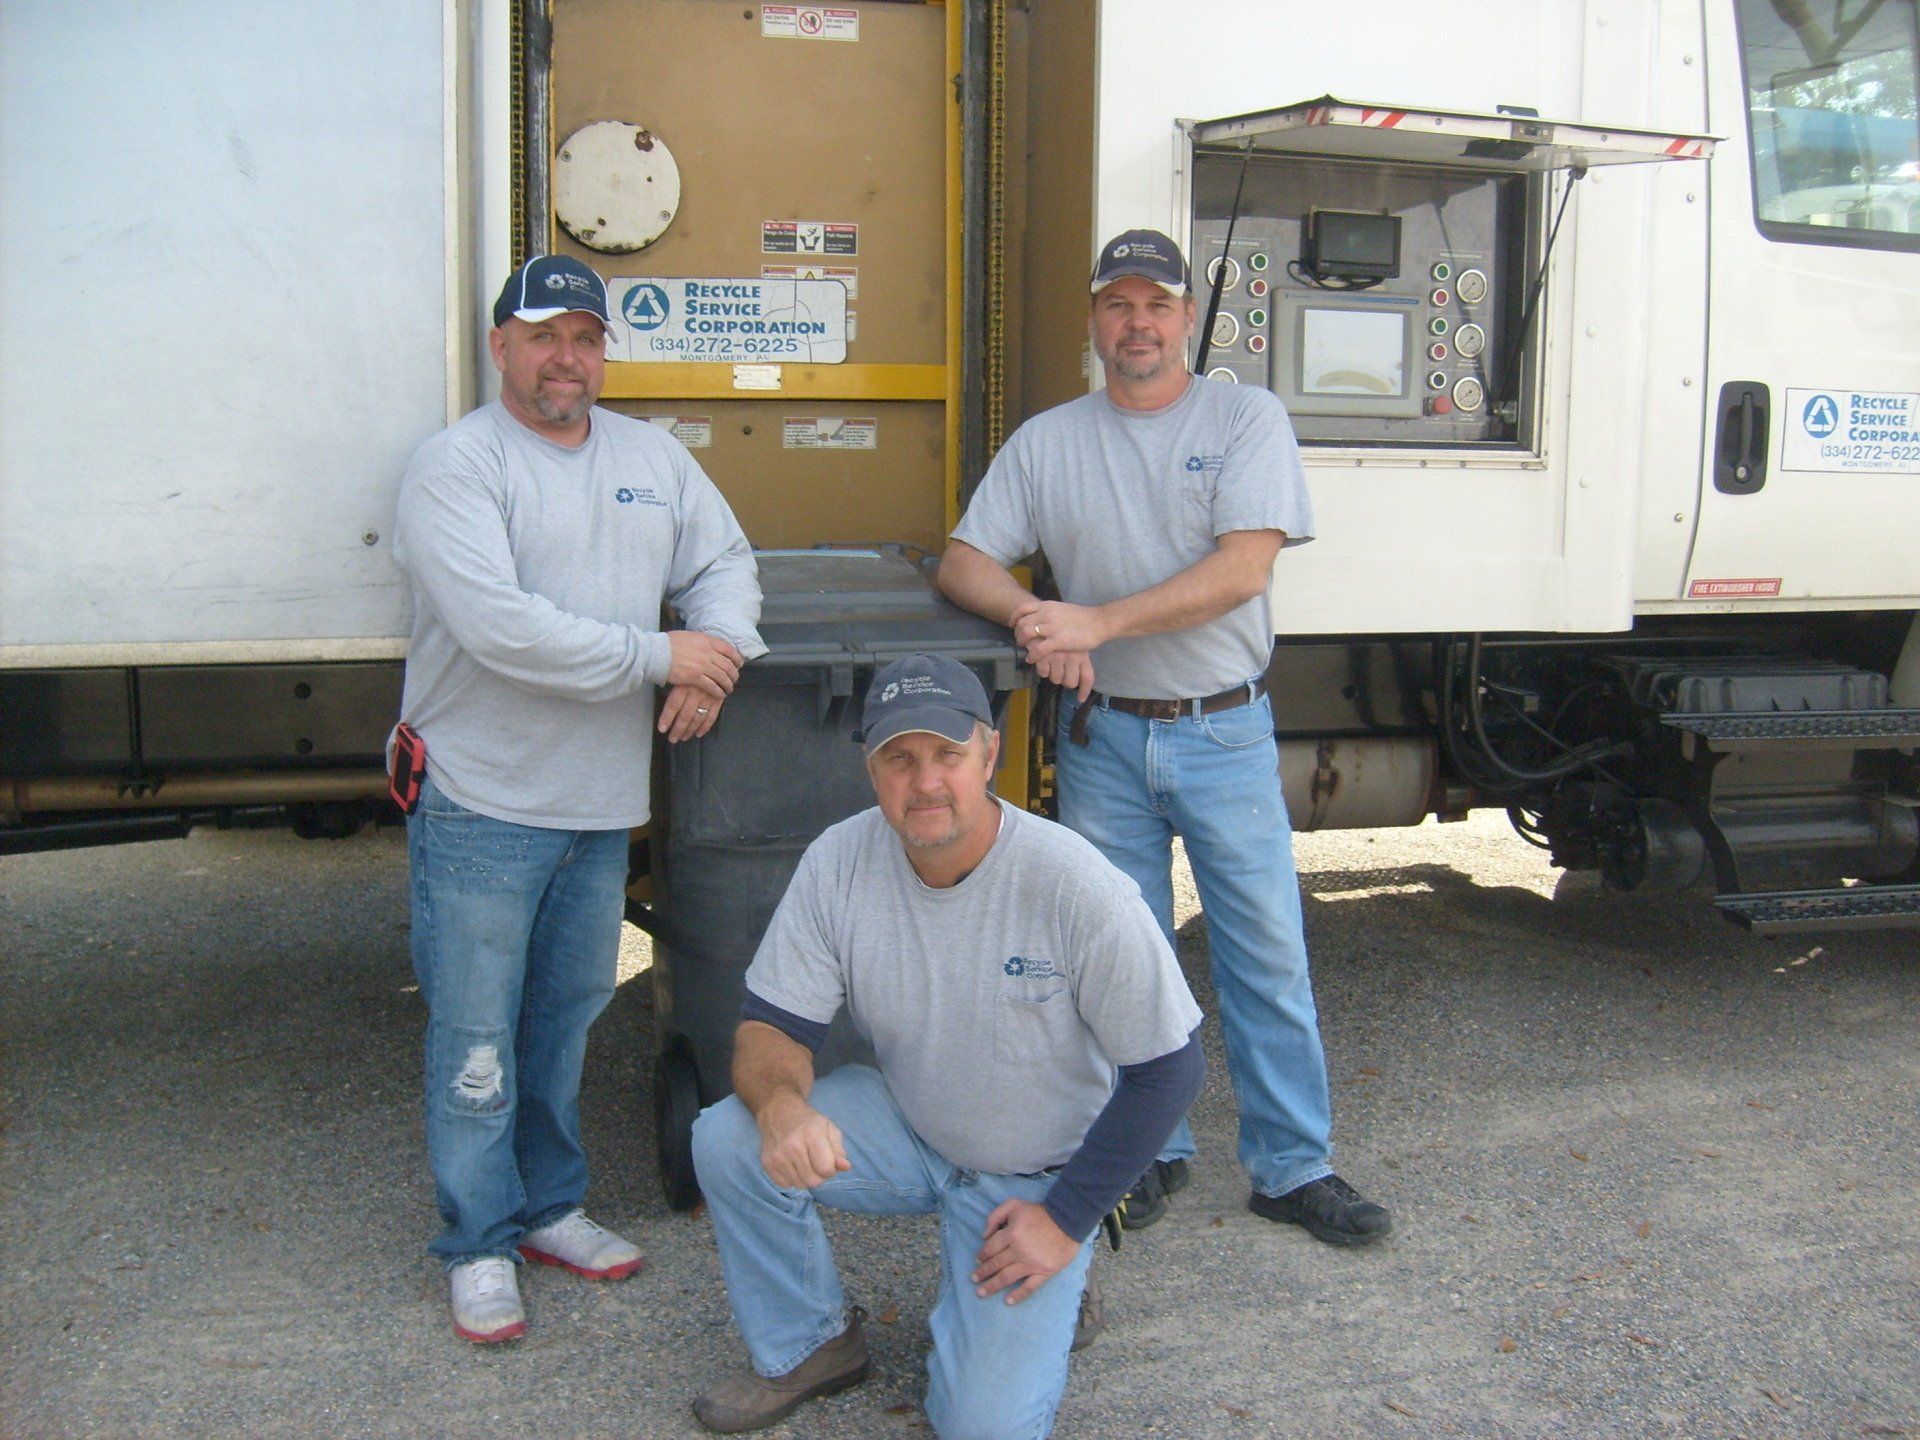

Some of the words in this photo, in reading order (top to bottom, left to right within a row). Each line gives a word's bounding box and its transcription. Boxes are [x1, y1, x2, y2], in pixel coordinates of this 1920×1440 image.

[684, 282, 761, 298] RECYCLE
[684, 300, 761, 316] SERVICE
[684, 317, 826, 334] CORPORATION
[1850, 394, 1908, 410] RECYCLE
[1850, 410, 1907, 426] SERVICE
[1848, 427, 1920, 442] CORPORA
[1694, 584, 1709, 593] FIRE
